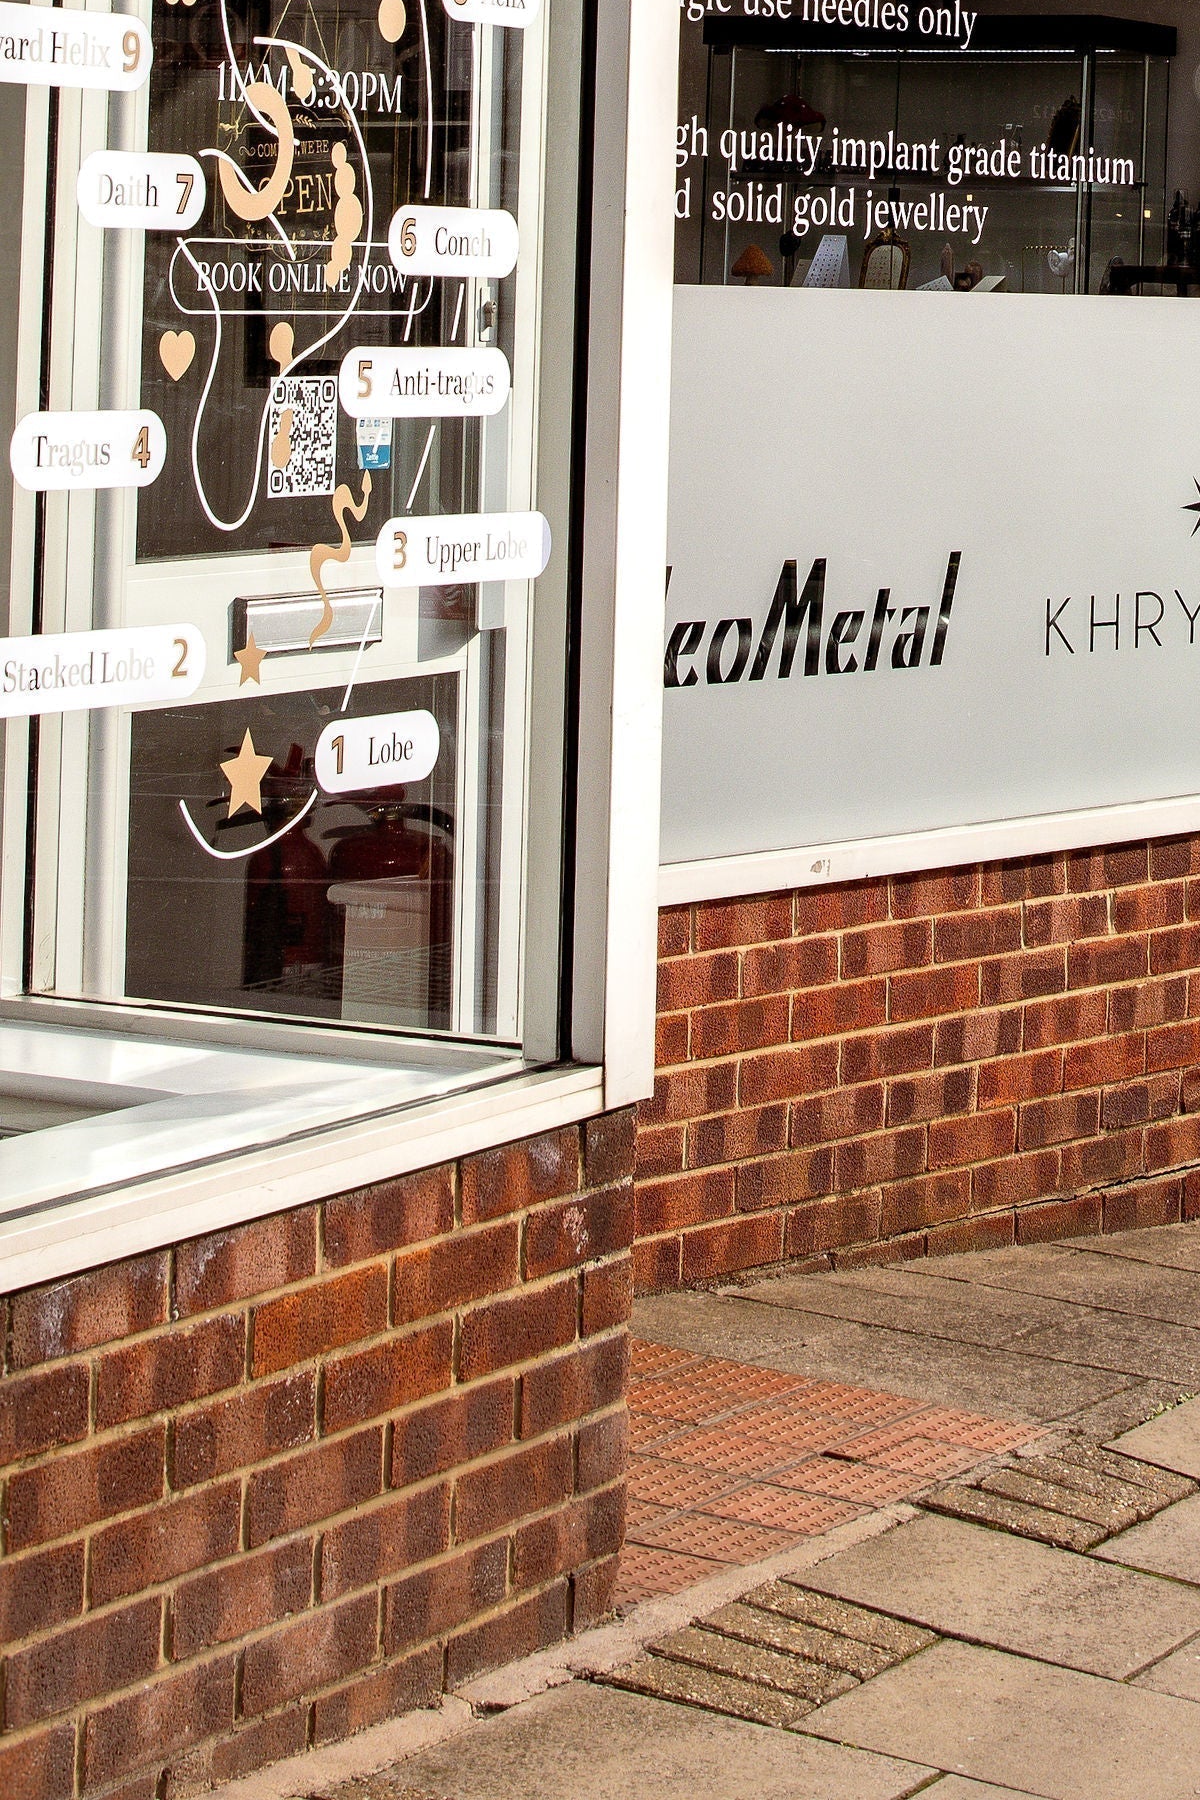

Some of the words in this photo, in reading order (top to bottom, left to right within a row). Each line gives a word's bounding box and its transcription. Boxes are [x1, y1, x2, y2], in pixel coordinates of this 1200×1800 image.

[0, 27, 43, 63] ard
[50, 31, 111, 69] Helix
[122, 29, 141, 73] 9
[719, 119, 823, 177] quality
[830, 124, 940, 183] implant
[947, 137, 1021, 186] grade
[1028, 142, 1136, 187] titanium
[97, 173, 160, 207] Daith
[175, 173, 194, 215] 7
[711, 181, 784, 226] solid
[792, 186, 856, 238] gold
[863, 191, 989, 246] jewellery
[400, 217, 417, 257] 6
[434, 226, 492, 257] Conch
[196, 261, 263, 293] BOOK
[356, 359, 373, 400] 5
[388, 367, 495, 405] Anti-tragus
[32, 434, 111, 477] Tragus
[131, 425, 151, 469] 4
[392, 530, 408, 570] 3
[425, 535, 482, 573] Upper
[664, 550, 962, 689] eoMetal
[3, 650, 95, 694] Stacked
[171, 637, 189, 679] 2
[330, 734, 345, 775] 1
[367, 732, 414, 766] Lobe
